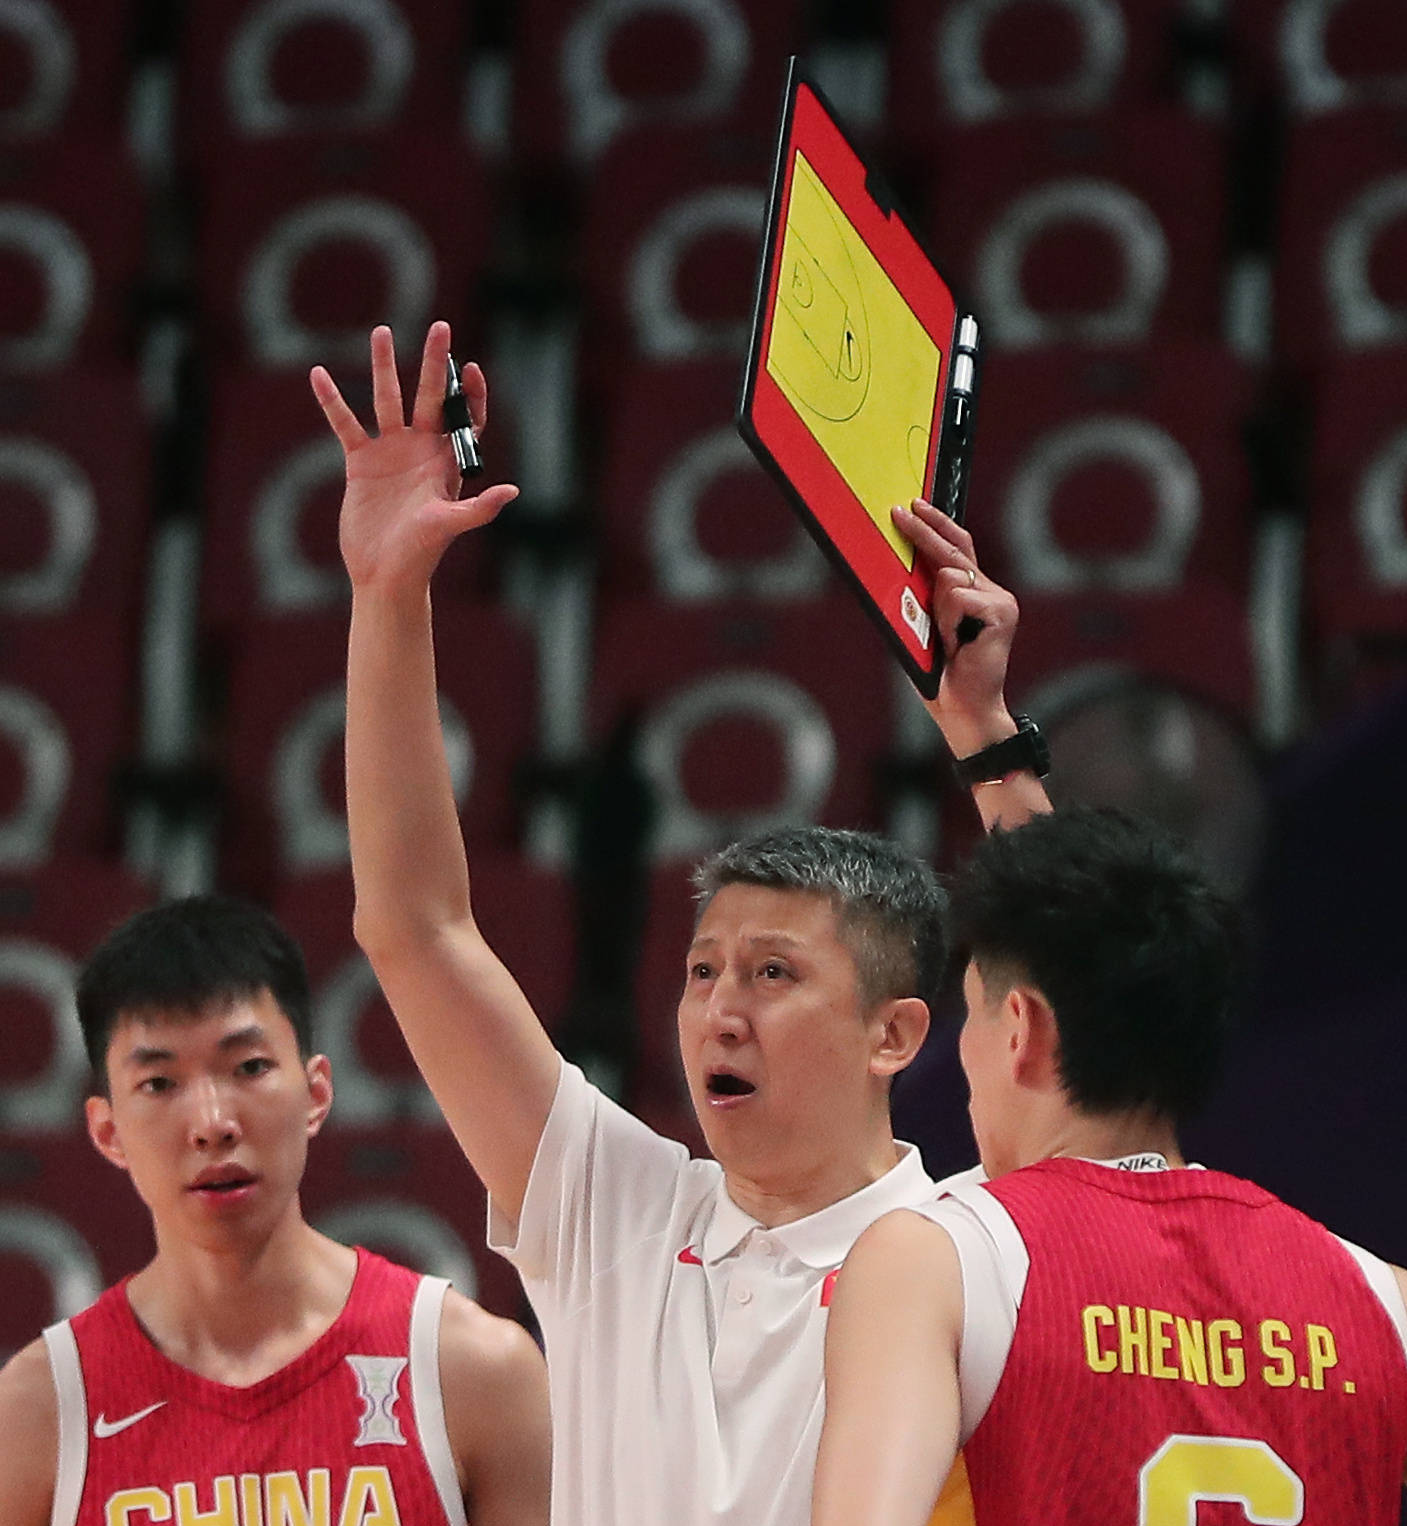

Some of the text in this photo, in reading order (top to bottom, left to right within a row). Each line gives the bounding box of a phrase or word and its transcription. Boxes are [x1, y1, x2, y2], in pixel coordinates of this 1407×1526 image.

[1117, 1157, 1167, 1171] NIKE
[1082, 1305, 1356, 1394] CHENG S.P.
